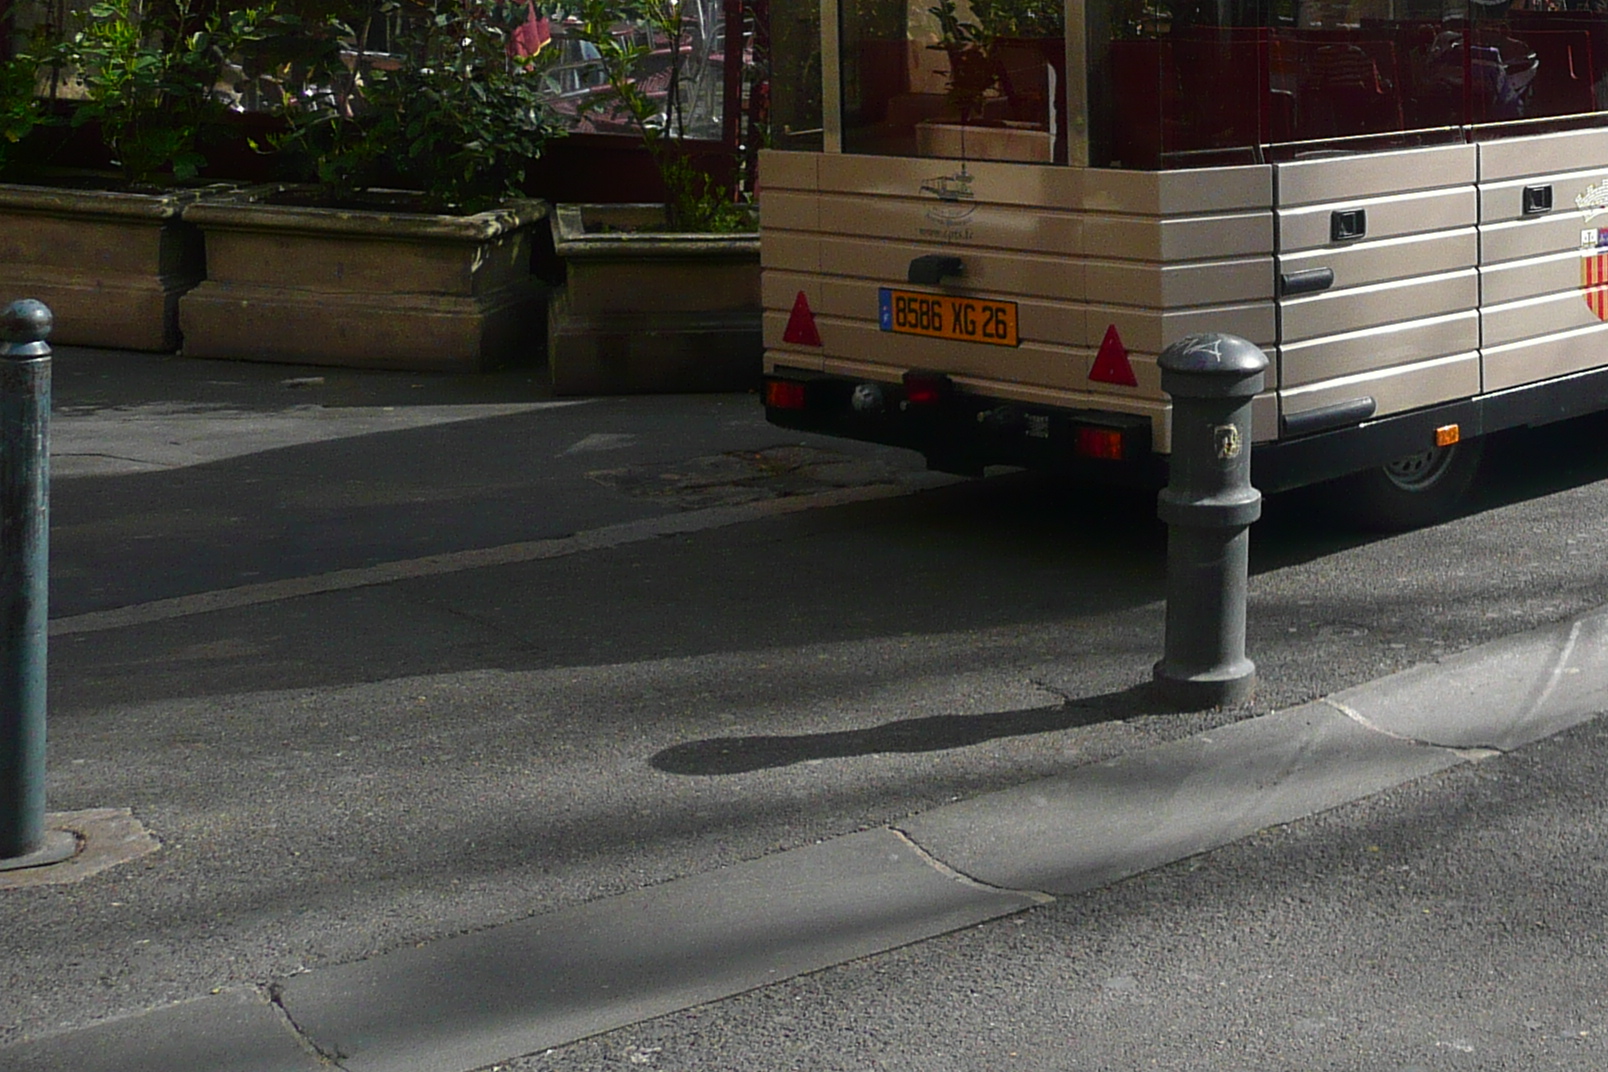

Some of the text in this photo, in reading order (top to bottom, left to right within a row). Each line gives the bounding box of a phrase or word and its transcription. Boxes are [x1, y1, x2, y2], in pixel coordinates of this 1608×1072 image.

[895, 295, 942, 332] 8586
[951, 301, 976, 336] XG
[982, 305, 1007, 340] 26
